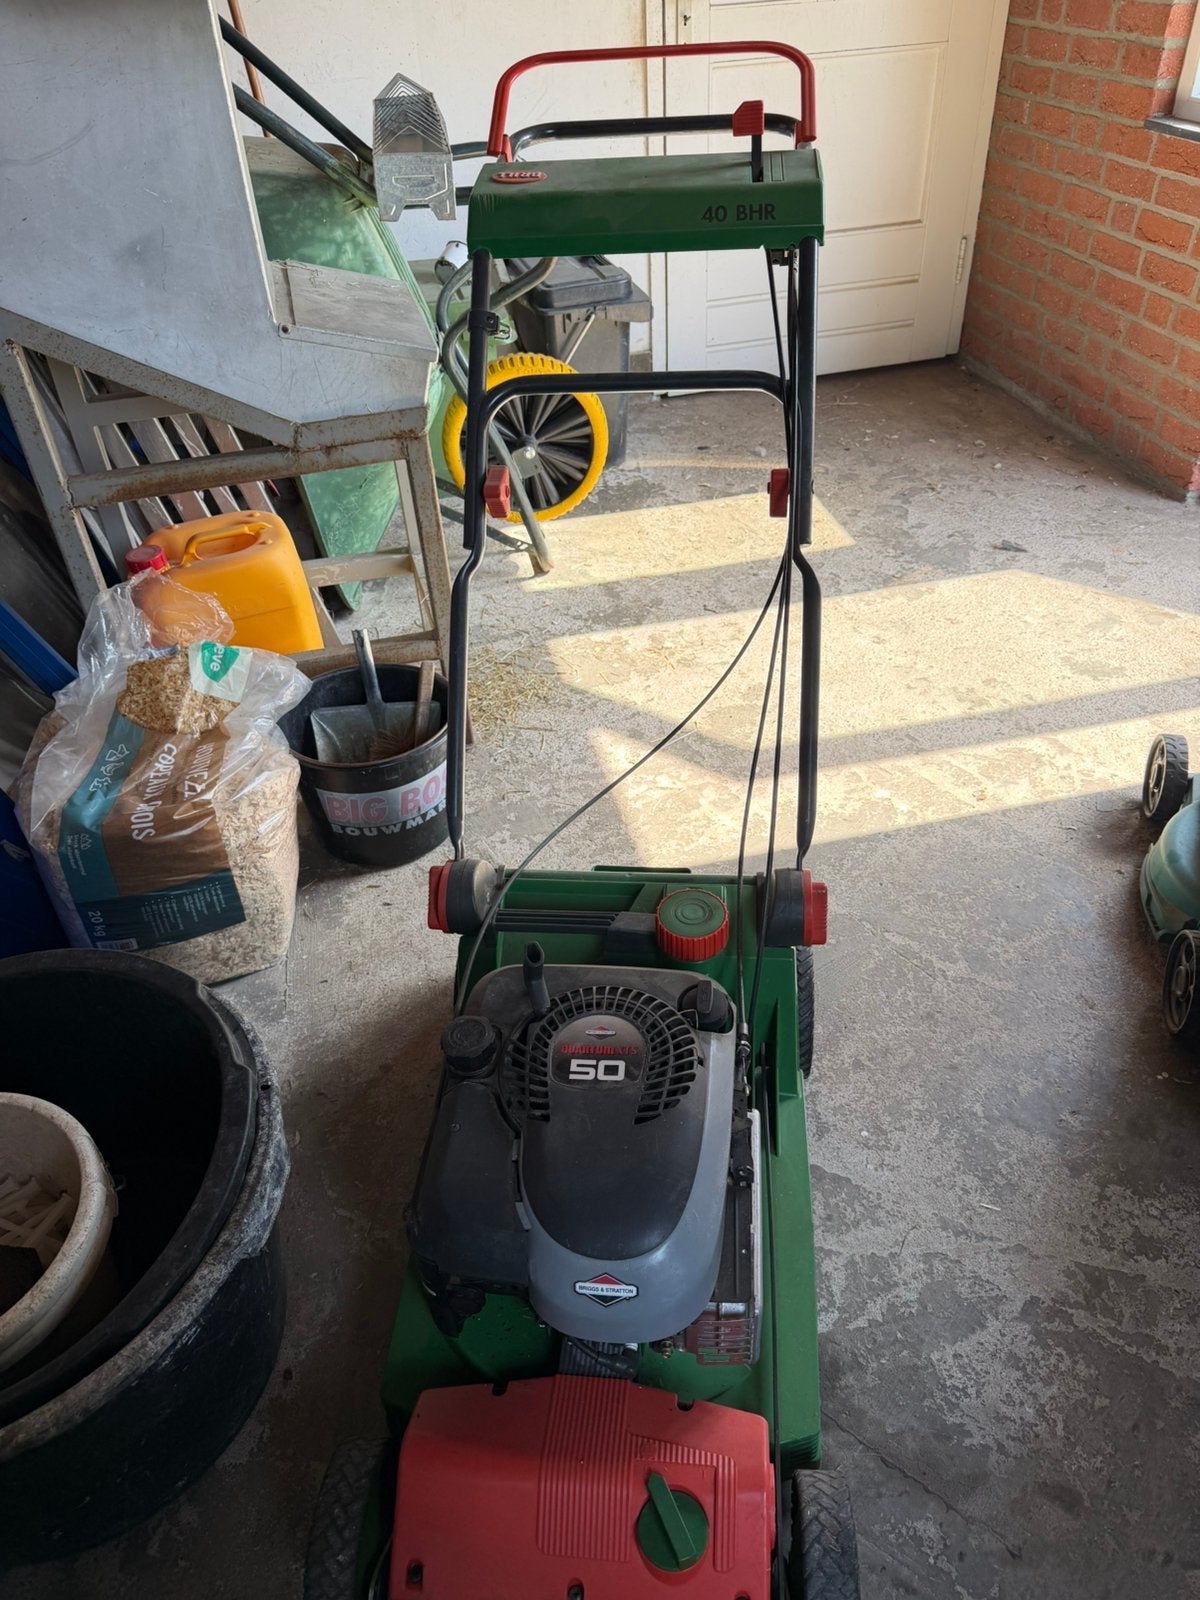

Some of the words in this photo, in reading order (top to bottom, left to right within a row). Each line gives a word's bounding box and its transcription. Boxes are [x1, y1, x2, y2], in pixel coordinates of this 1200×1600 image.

[701, 205, 728, 223] 40
[736, 203, 777, 221] BHR
[326, 796, 387, 823] BIG
[88, 910, 104, 924] 20
[569, 1058, 626, 1081] 50
[578, 1284, 600, 1292] BRIGGS
